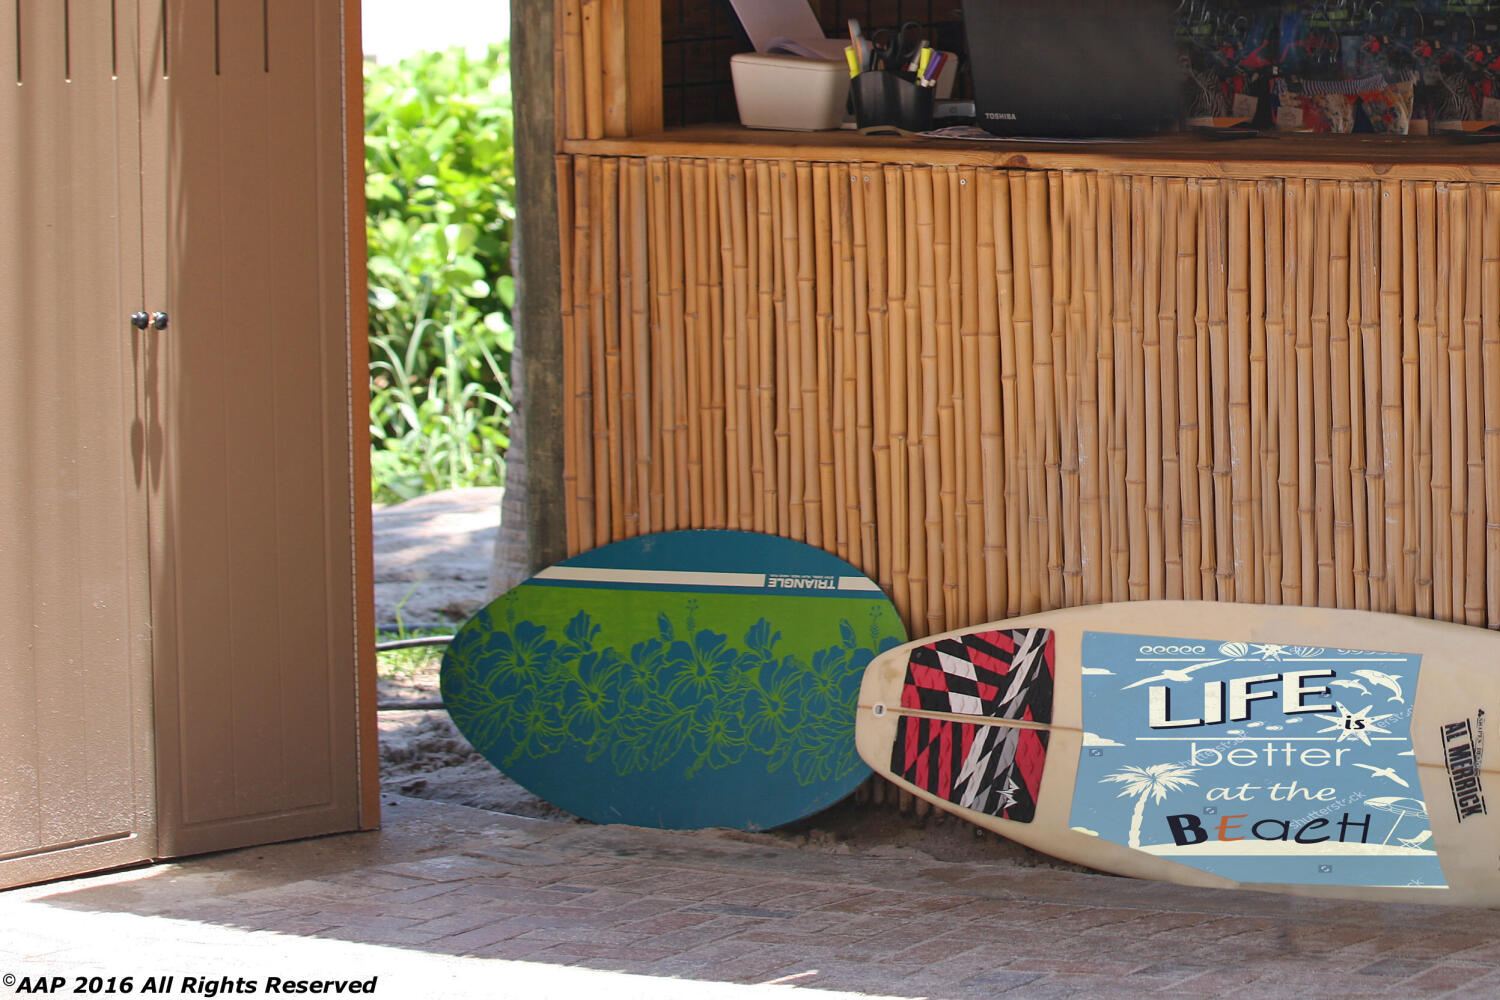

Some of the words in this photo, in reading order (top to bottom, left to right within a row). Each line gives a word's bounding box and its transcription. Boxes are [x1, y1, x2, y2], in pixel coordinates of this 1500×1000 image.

[984, 112, 1017, 120] TOSHIBA
[767, 577, 836, 590] TRIANGLE
[1149, 669, 1337, 729] LIFE
[1345, 715, 1366, 731] is
[1444, 721, 1468, 742] AL
[1191, 742, 1351, 767] better
[1206, 783, 1262, 801] at
[1267, 781, 1337, 802] the
[1448, 743, 1482, 819] MERRICK
